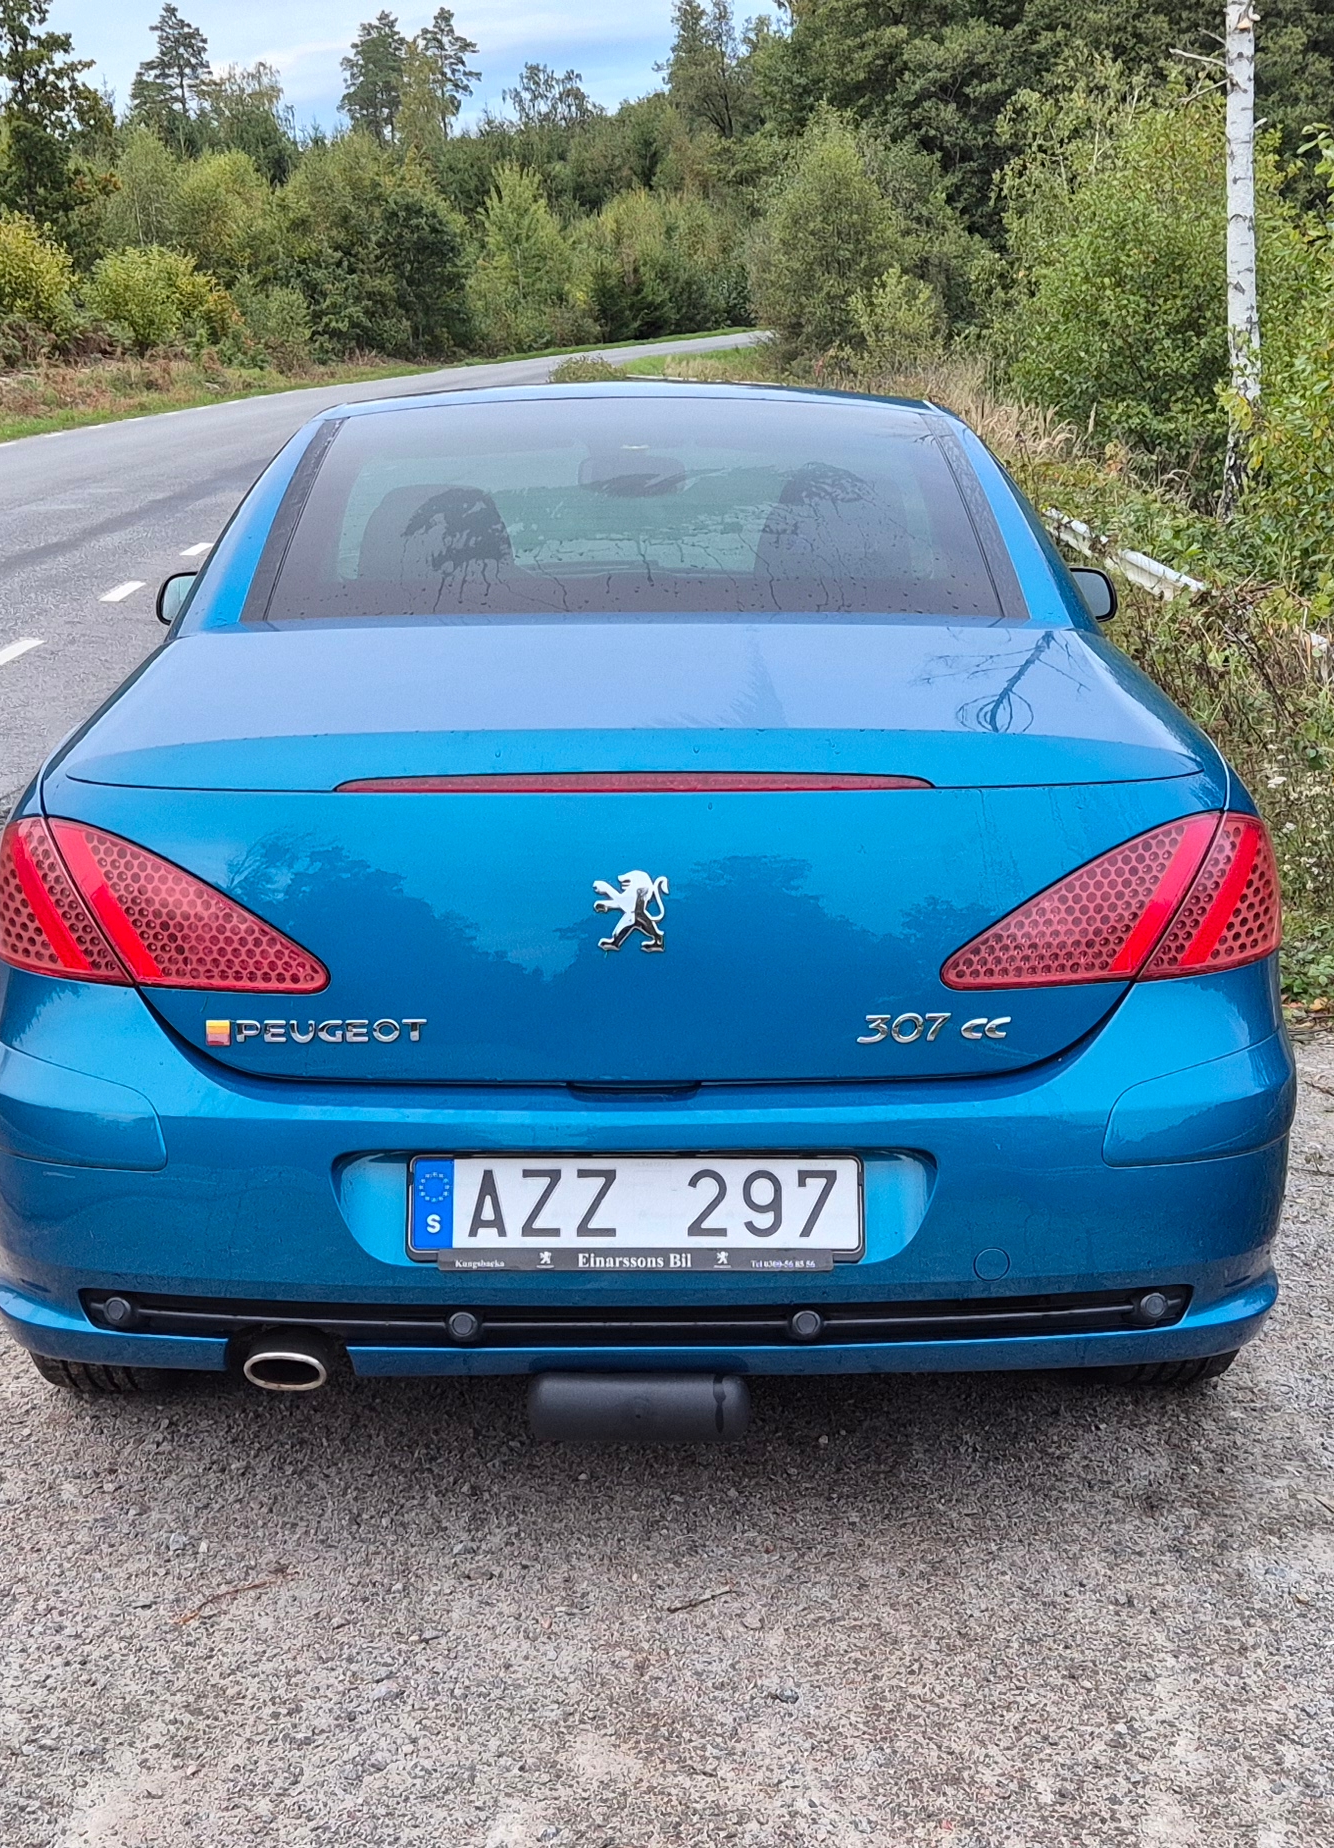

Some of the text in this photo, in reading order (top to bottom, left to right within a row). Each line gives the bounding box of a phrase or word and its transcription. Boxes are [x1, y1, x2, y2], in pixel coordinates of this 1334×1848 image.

[234, 1018, 428, 1043] PEUGEOT
[856, 1012, 952, 1044] 307
[468, 1168, 838, 1237] AZZ 297
[426, 1214, 441, 1233] S
[455, 1260, 505, 1269] Kungsbacka
[578, 1253, 692, 1268] Einarssons Bil
